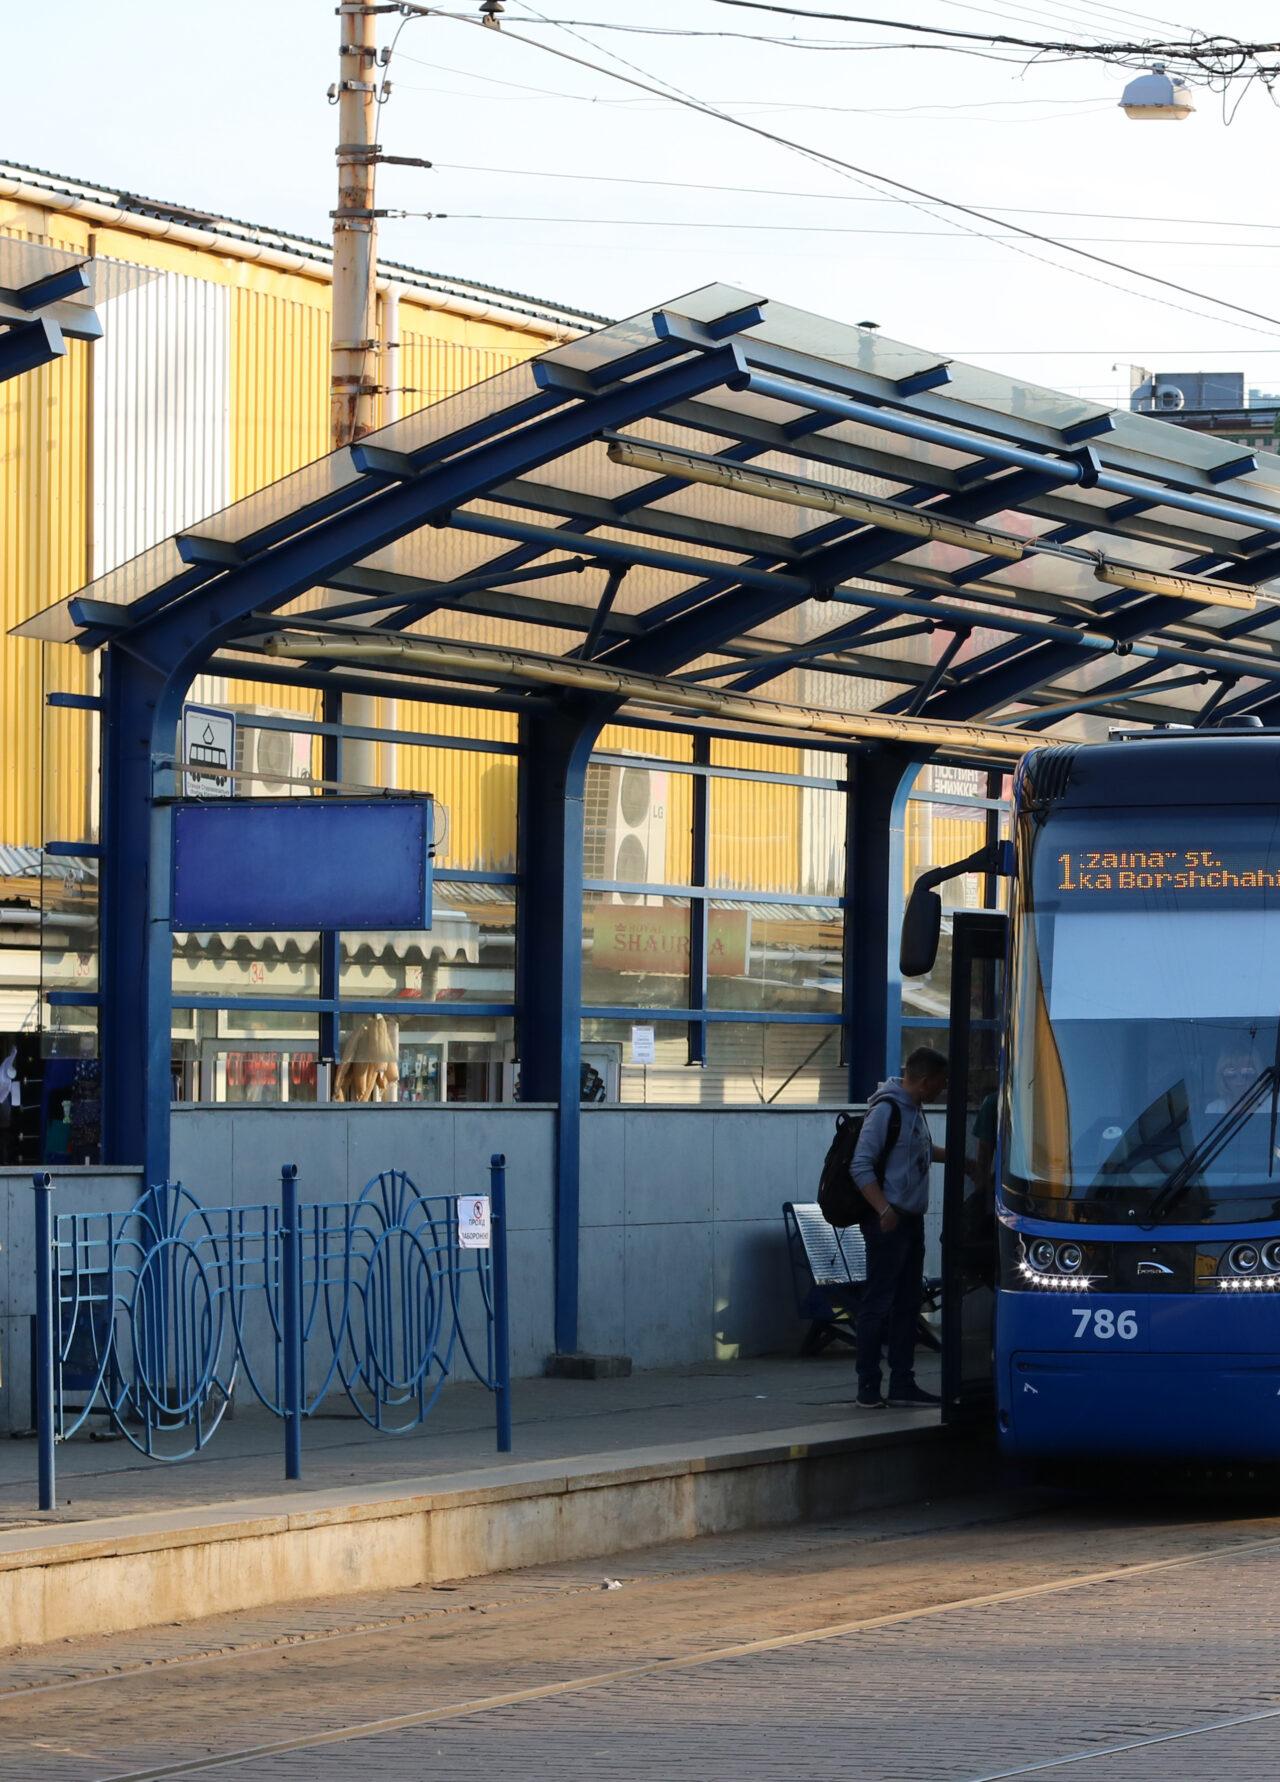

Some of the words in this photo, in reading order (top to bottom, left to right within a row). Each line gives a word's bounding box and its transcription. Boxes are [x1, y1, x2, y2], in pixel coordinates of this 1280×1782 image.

[653, 804, 664, 819] LG
[1058, 853, 1077, 890] 1
[613, 933, 725, 956] SHAURA
[1071, 1308, 1139, 1340] 786
